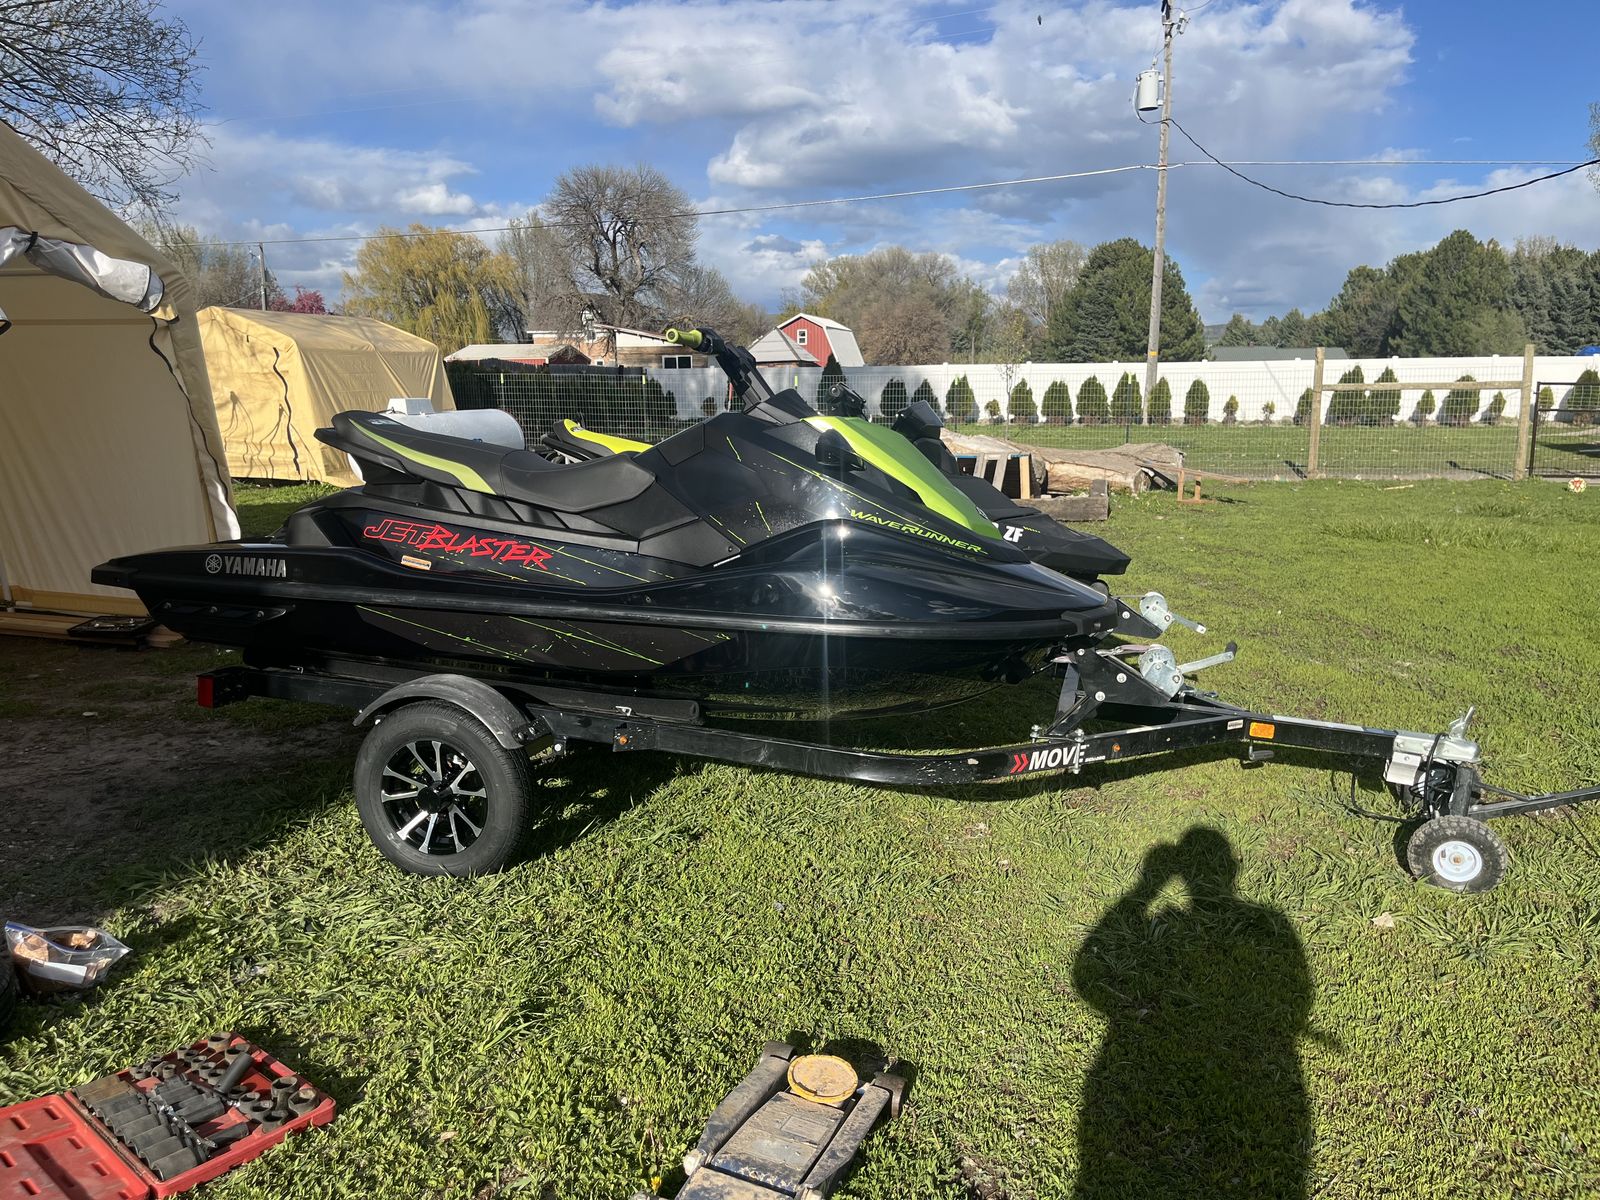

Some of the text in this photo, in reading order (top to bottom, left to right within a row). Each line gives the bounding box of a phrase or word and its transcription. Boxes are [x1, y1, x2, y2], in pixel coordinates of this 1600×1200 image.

[1003, 525, 1024, 542] ZF
[224, 556, 286, 577] YAMAHA
[1029, 745, 1086, 770] MOVE
